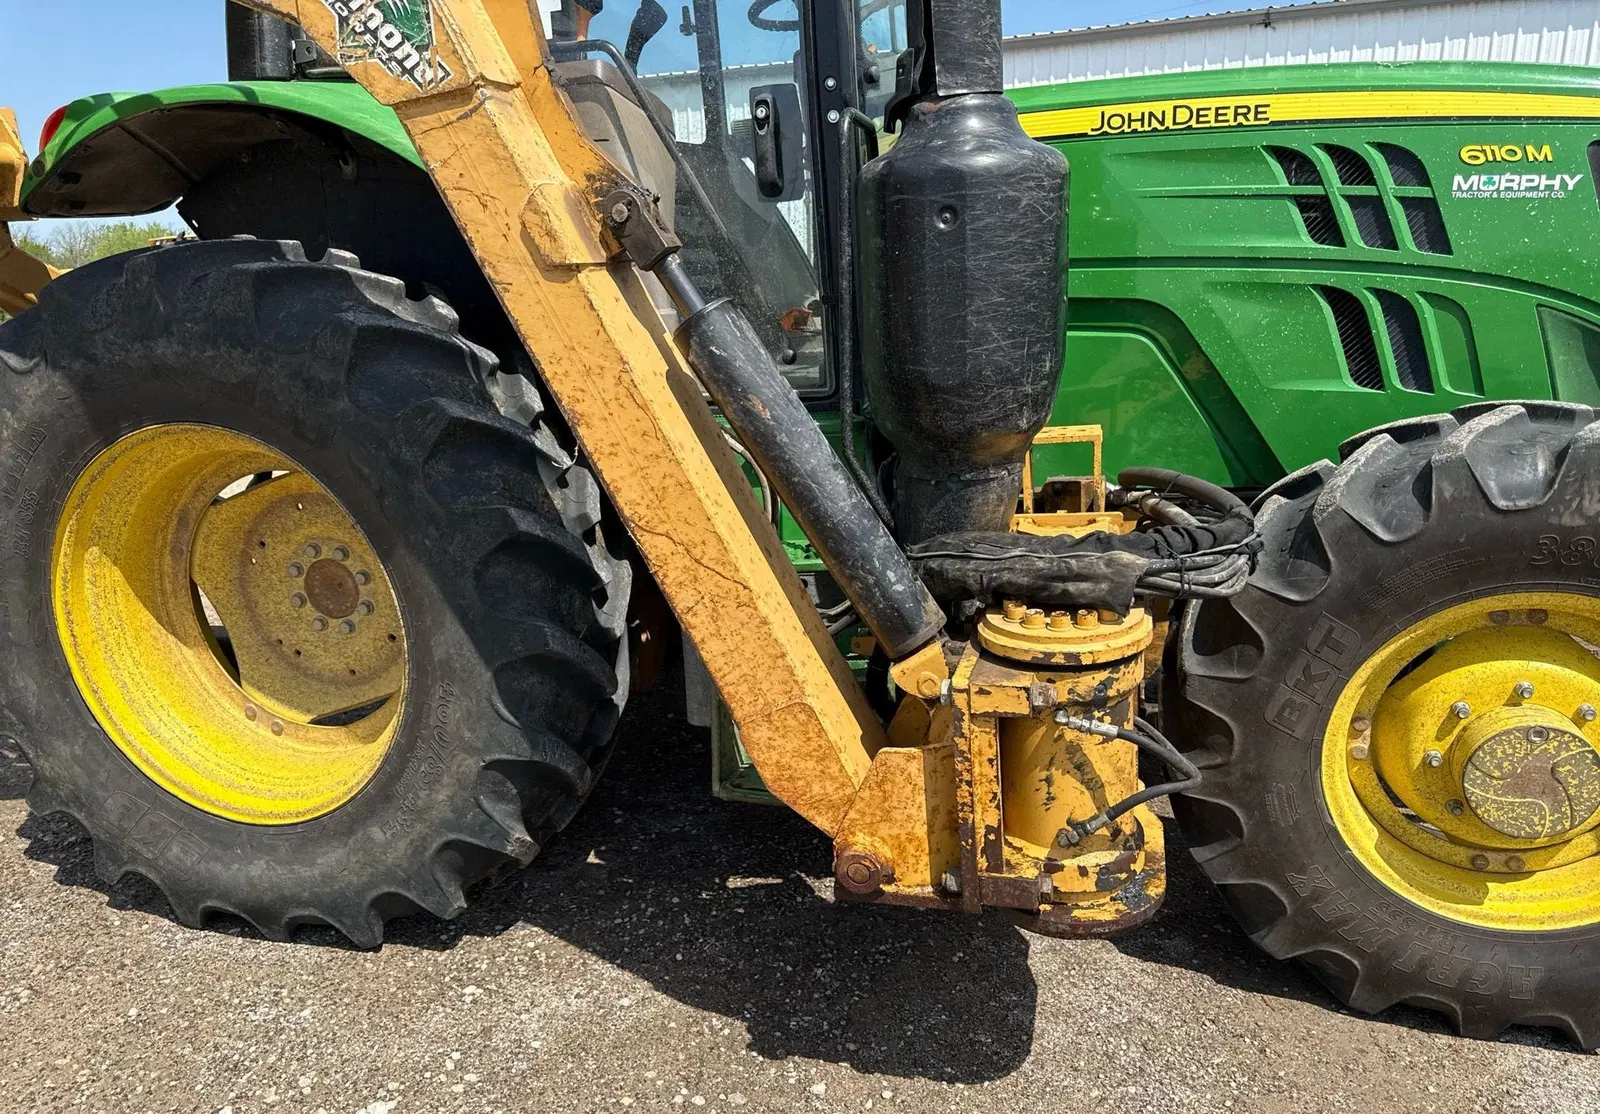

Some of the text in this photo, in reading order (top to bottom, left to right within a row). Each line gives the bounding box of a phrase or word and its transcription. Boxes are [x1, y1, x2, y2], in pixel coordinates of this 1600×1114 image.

[1090, 104, 1270, 132] JOHN DEERE
[1452, 173, 1584, 191] MURPHY
[1452, 191, 1566, 199] TRACTOR & EQUIPMENT CO.
[1268, 617, 1354, 736] BKT
